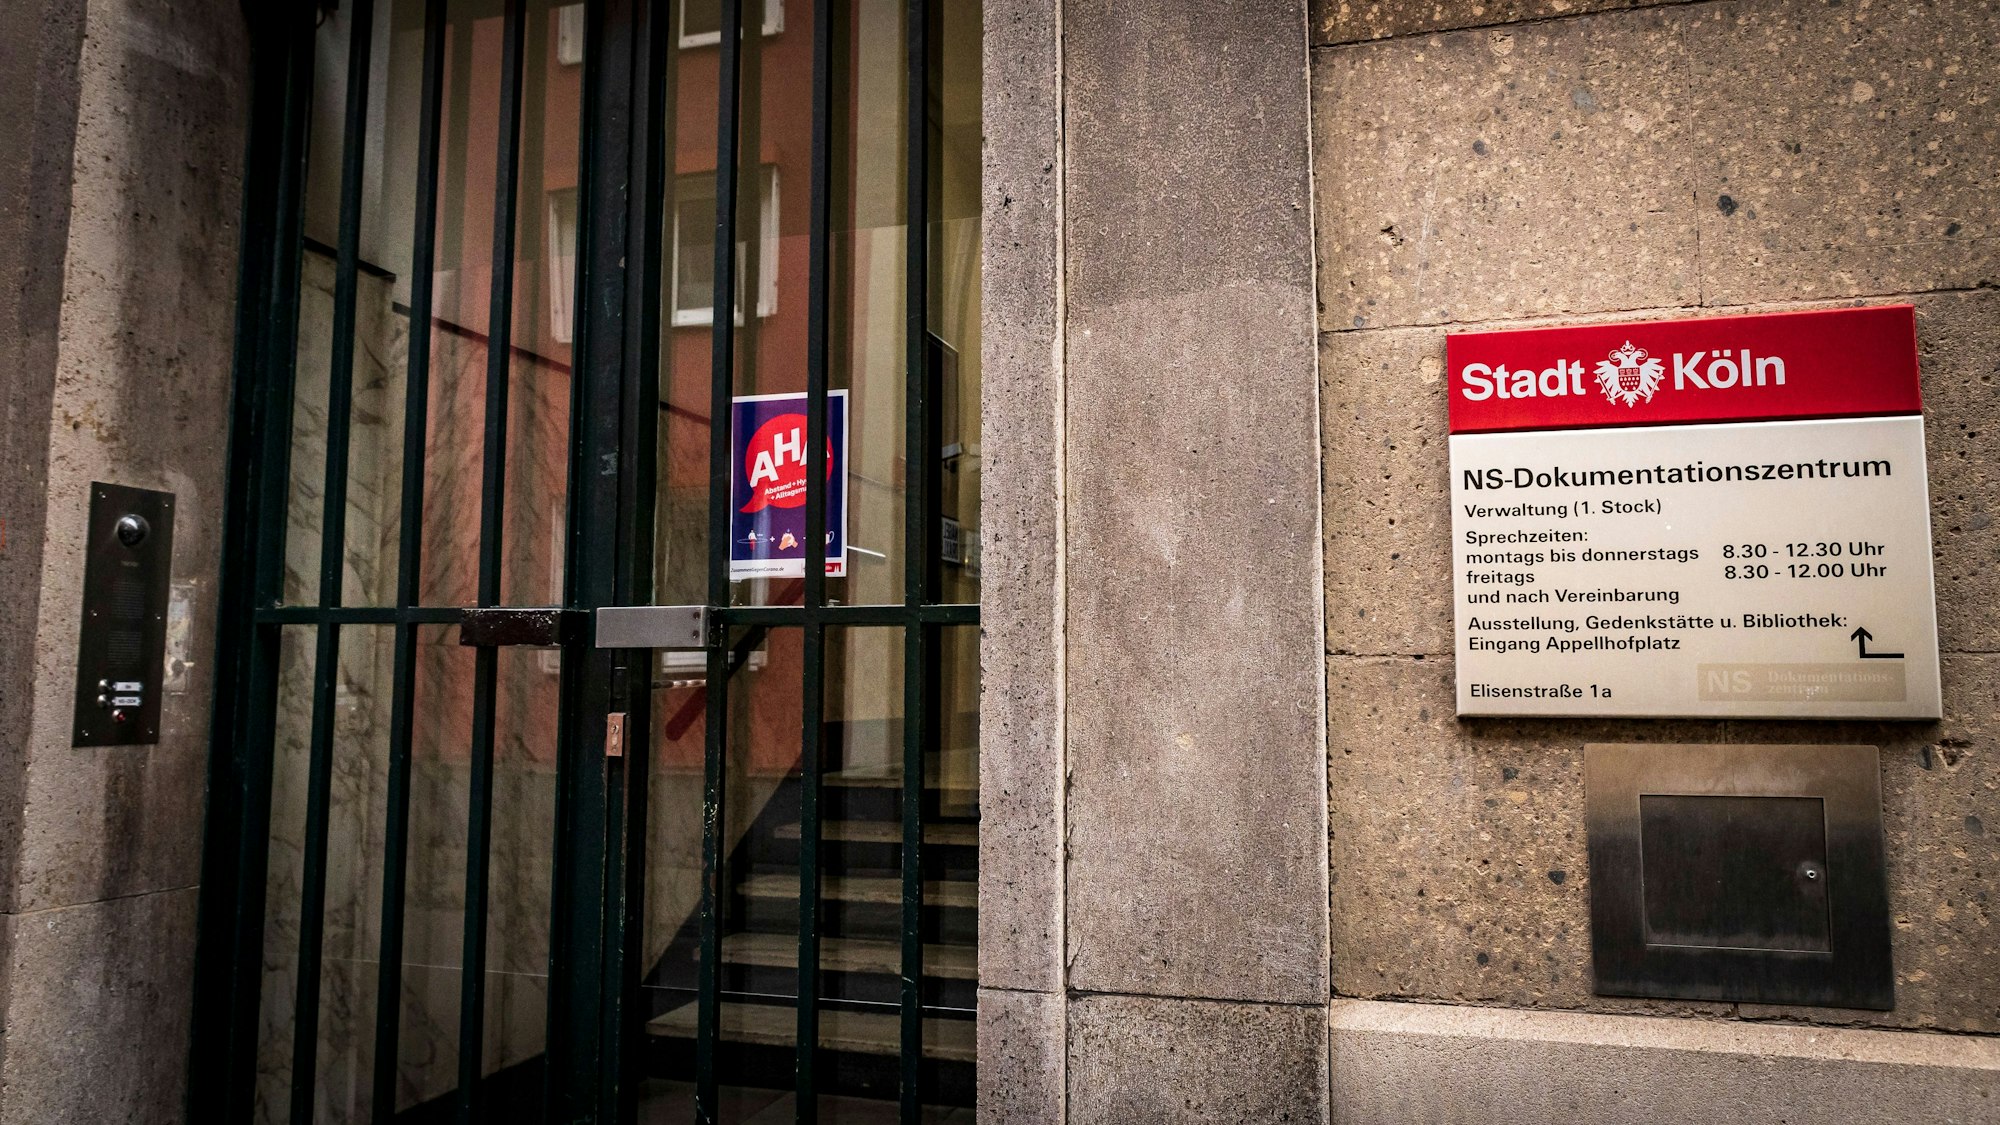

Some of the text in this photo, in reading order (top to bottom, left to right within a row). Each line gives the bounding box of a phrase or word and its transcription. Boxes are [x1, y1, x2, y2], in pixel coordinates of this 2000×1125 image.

[1461, 349, 1786, 401] Stadt Köln
[750, 427, 830, 488] AH
[1463, 457, 1892, 490] NS-Dokumentationszentrum
[764, 481, 792, 496] Abstand
[1464, 498, 1662, 518] Verwaltung (1. Stock)
[1465, 529, 1589, 547] Sprechzeiten:
[1466, 551, 1545, 566] montags
[1550, 549, 1576, 563] bis
[1582, 548, 1699, 563] donnerstags
[1722, 544, 1767, 559] 8.30
[1785, 542, 1842, 558] 12.30
[1849, 541, 1885, 556] Uhr
[1467, 570, 1535, 586] freitags
[1724, 565, 1769, 580] 8.30
[1787, 563, 1844, 579] 12.00
[1851, 563, 1887, 578] Uhr
[1467, 588, 1680, 605] und nach Vereinbarung
[1468, 613, 1848, 633] Ausstellung, Gedenkstätte u. Bibliothek:
[1469, 635, 1681, 653] Eingang Appellhofplatz
[1470, 683, 1583, 698] Elisenstraße
[1706, 670, 1895, 694] NS Dokumentations-
